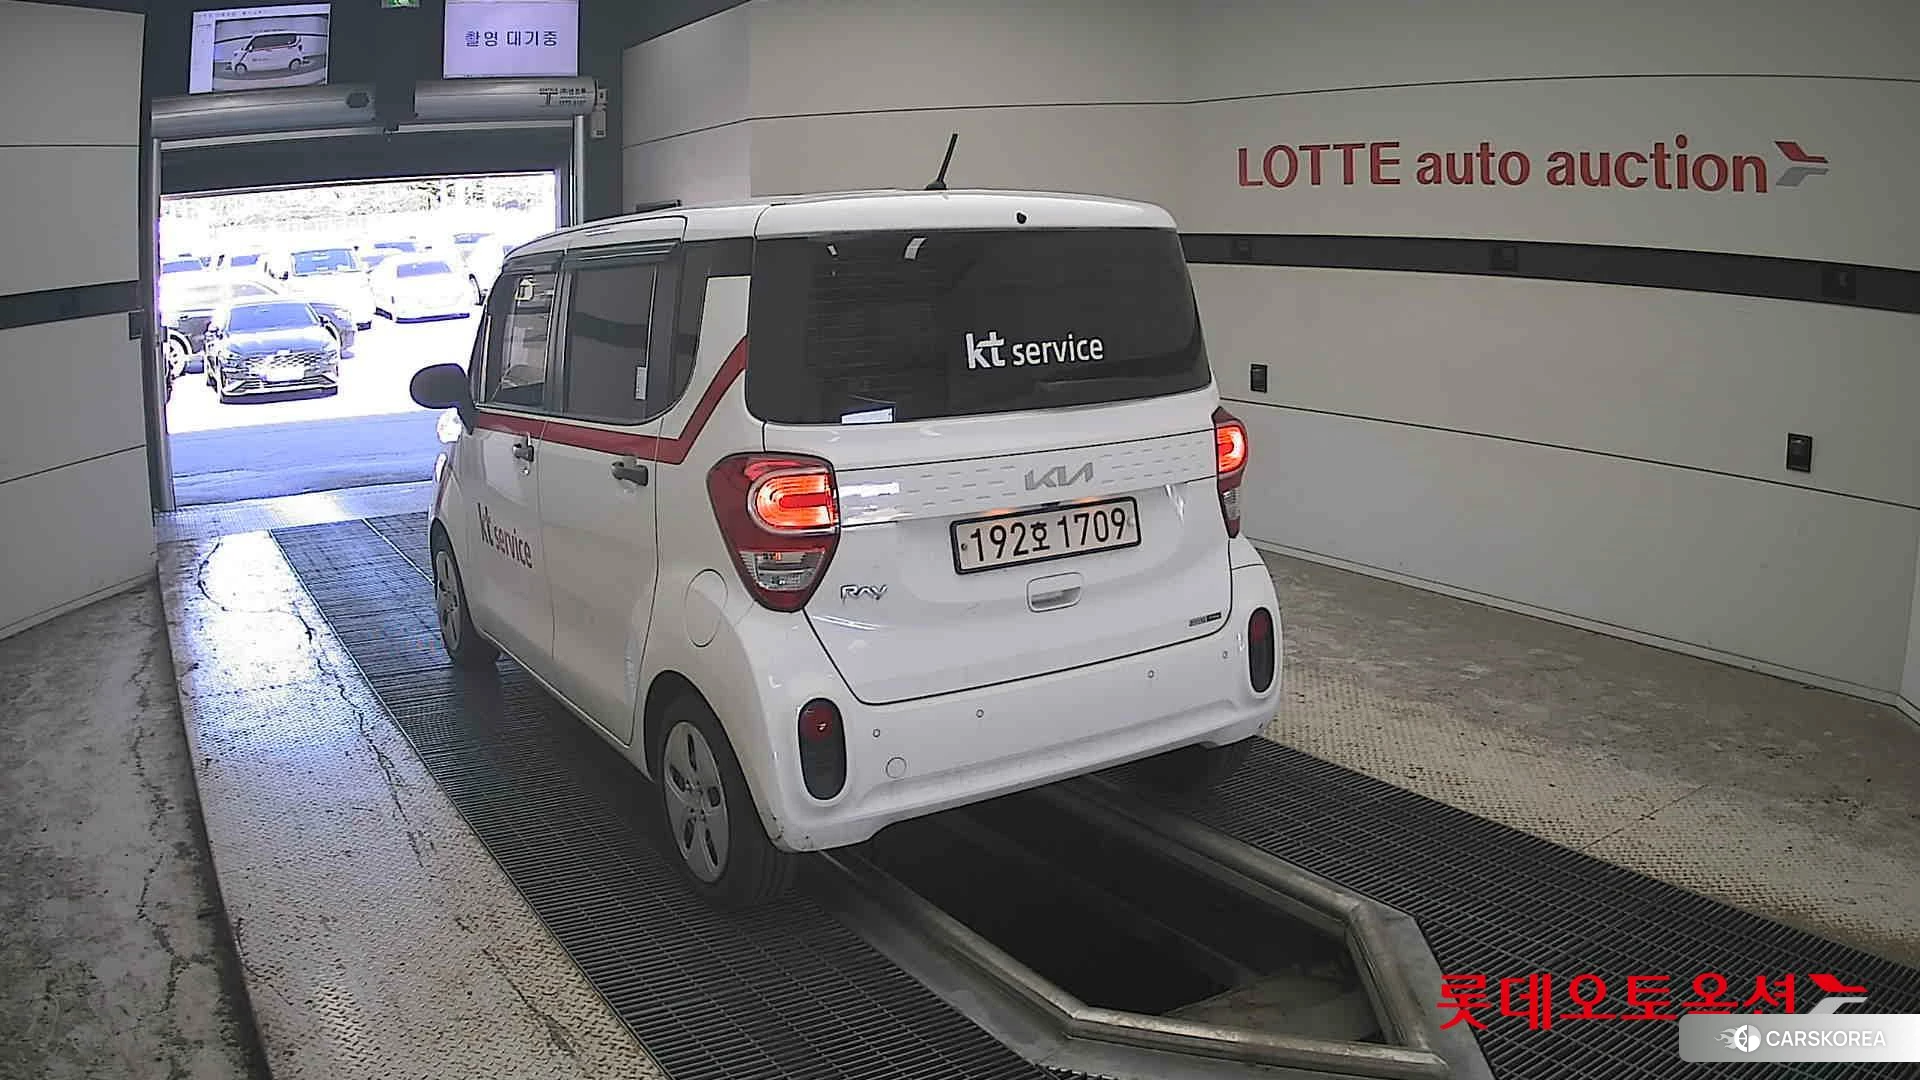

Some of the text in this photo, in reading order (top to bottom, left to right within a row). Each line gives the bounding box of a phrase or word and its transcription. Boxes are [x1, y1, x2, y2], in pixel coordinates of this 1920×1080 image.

[464, 31, 557, 47] 촬영 대기중
[1238, 134, 1767, 193] LOTTE auto auction
[965, 331, 1104, 369] kt service
[1024, 462, 1094, 491] KIA
[477, 502, 533, 569] kt service
[970, 507, 1126, 562] 192호 1709
[840, 583, 888, 601] RAY
